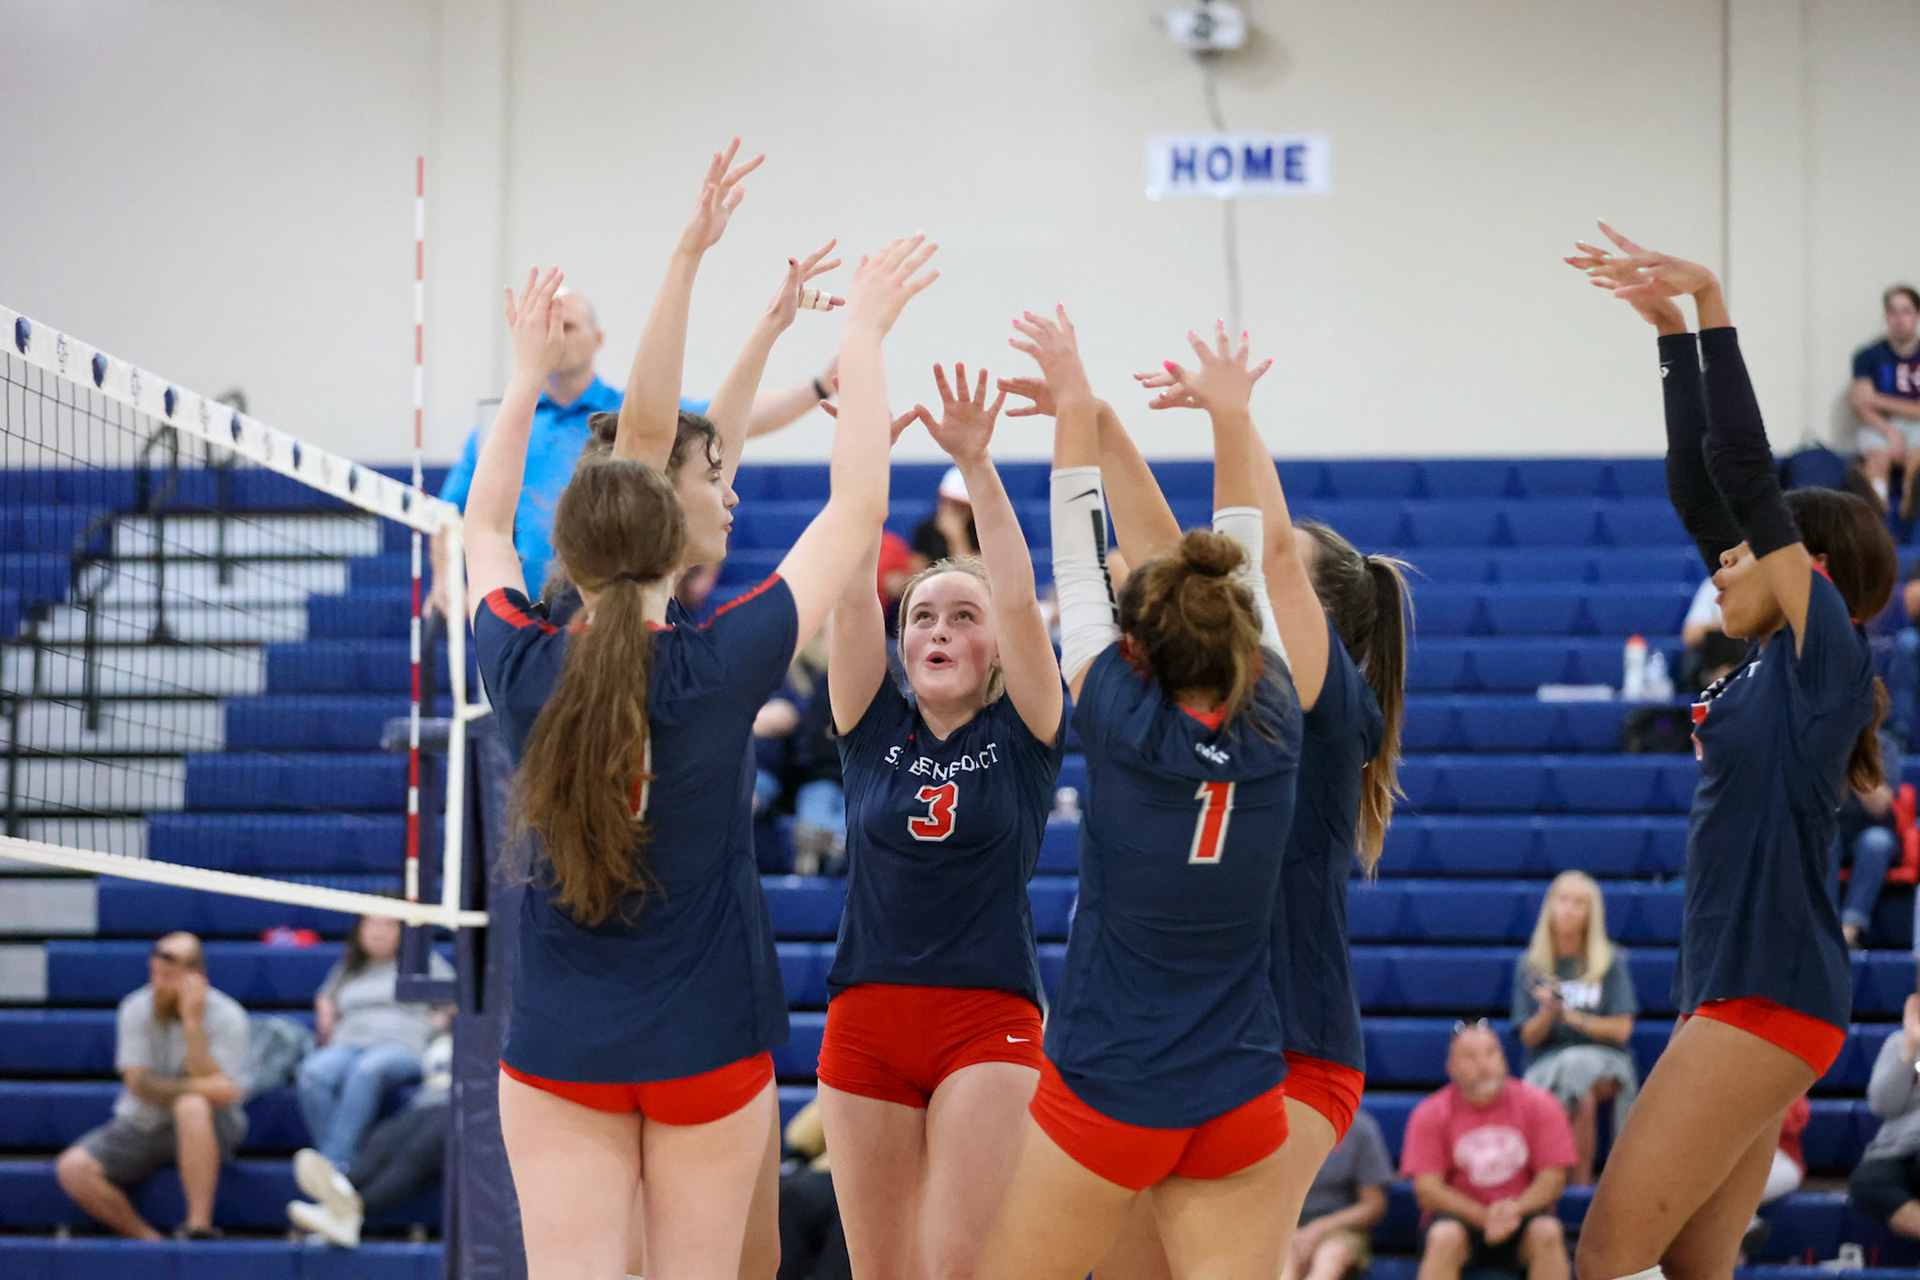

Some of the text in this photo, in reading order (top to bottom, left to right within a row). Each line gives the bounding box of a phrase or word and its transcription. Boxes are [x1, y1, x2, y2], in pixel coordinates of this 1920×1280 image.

[1170, 143, 1307, 183] HOME
[884, 742, 998, 780] S BENEDCT
[907, 780, 959, 842] 3
[1188, 781, 1236, 864] 1
